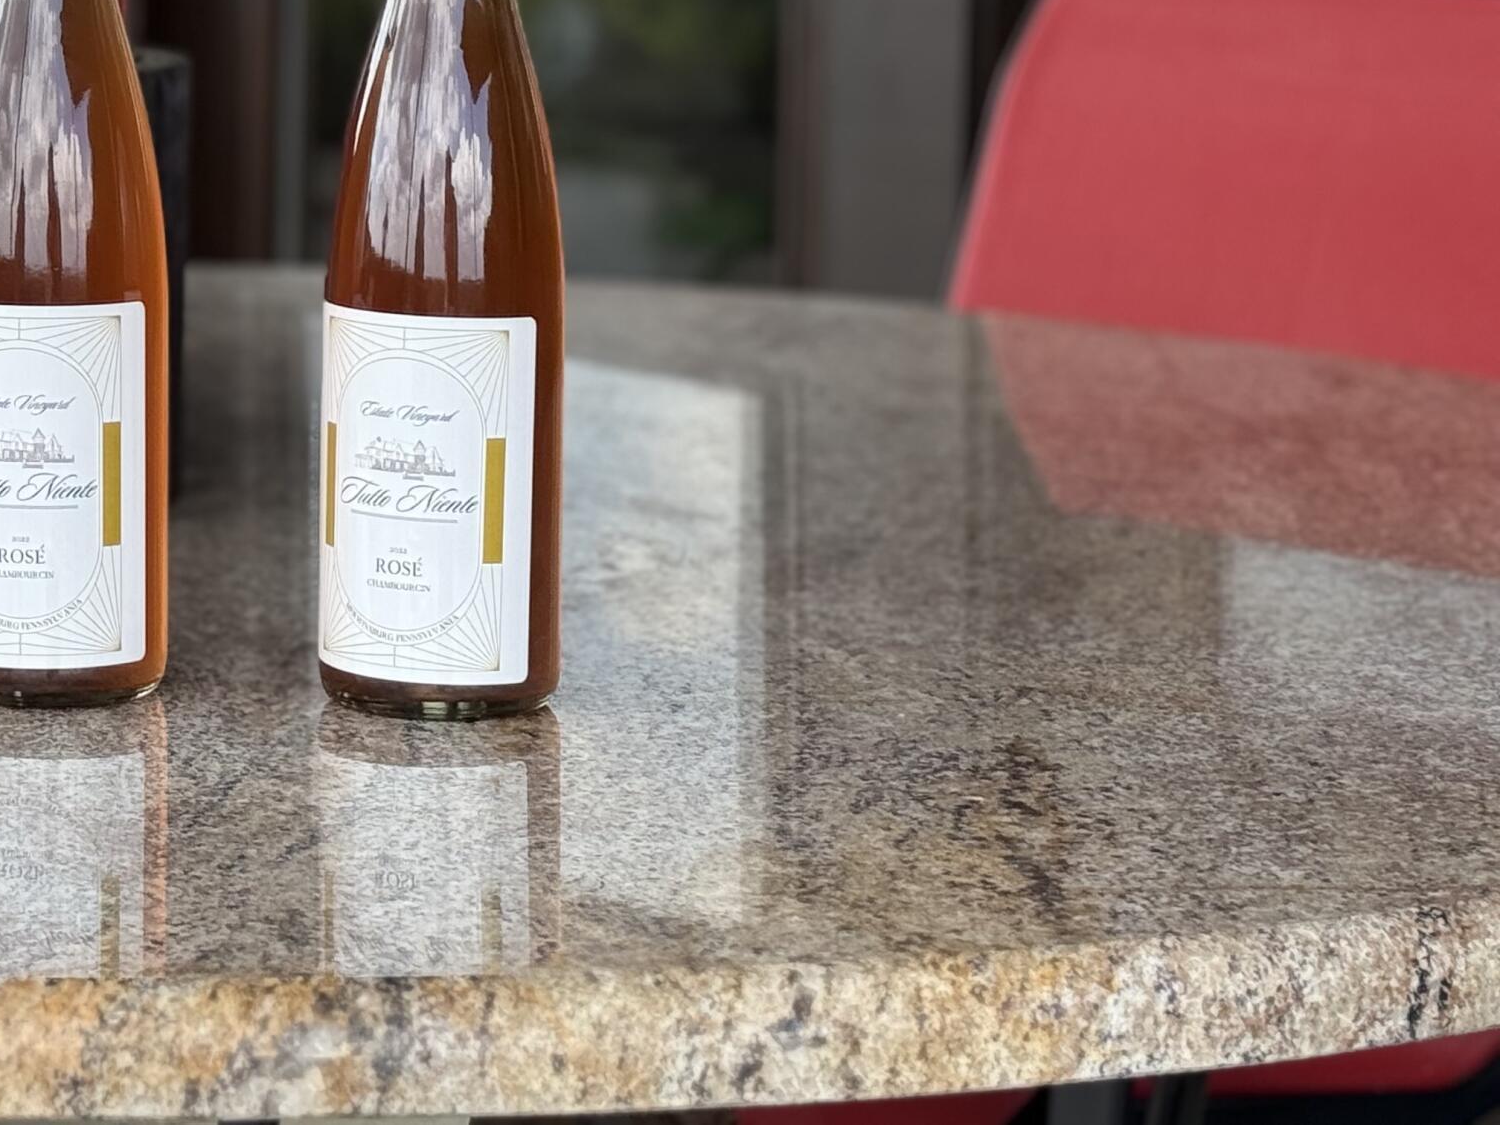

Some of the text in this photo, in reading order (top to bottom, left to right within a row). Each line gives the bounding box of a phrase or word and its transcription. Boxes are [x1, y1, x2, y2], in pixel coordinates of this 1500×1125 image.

[14, 394, 76, 416] Vineyard
[396, 405, 460, 427] Vineyard
[375, 556, 423, 578] ROSÉ
